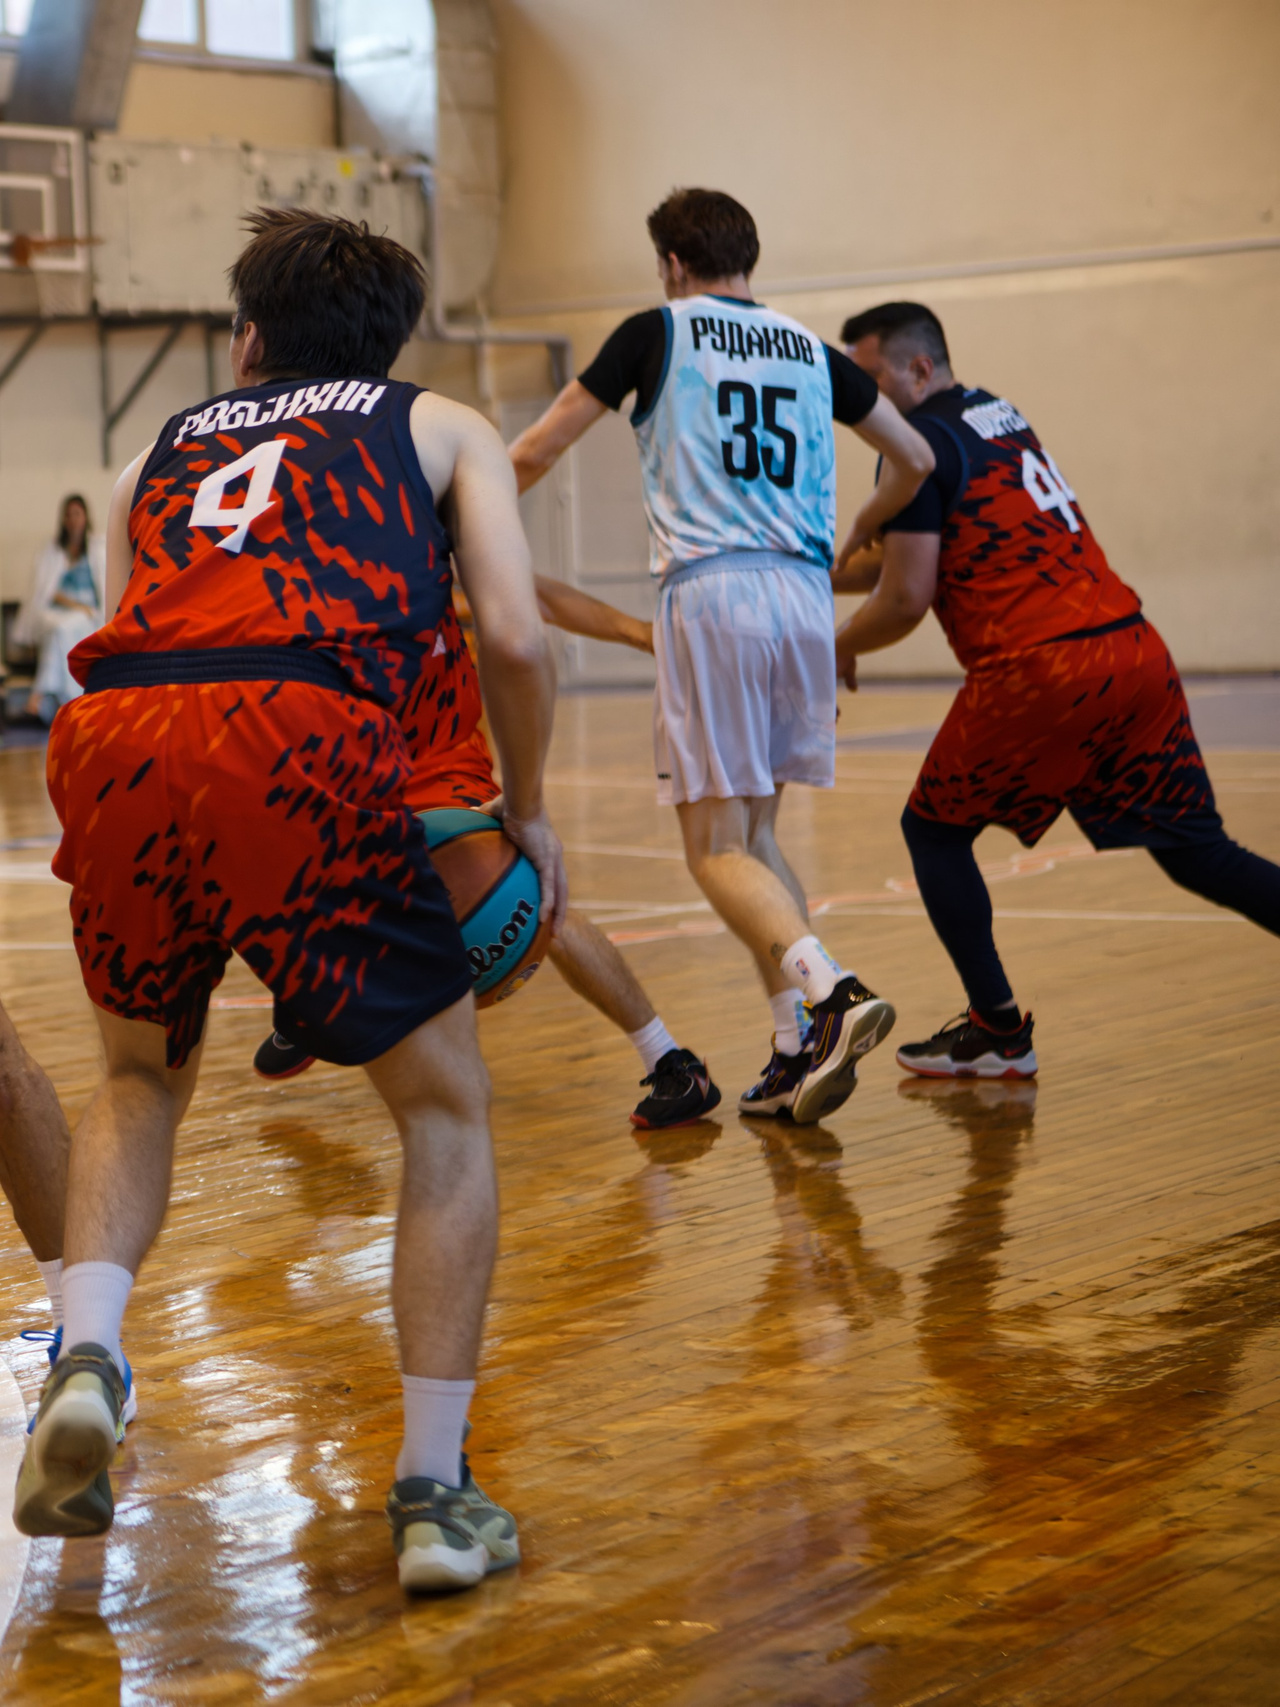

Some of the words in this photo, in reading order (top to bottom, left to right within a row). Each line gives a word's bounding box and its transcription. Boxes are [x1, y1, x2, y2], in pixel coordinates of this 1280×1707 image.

[690, 316, 815, 367] РУДАКОВ
[717, 381, 797, 489] 35
[188, 438, 289, 554] 4
